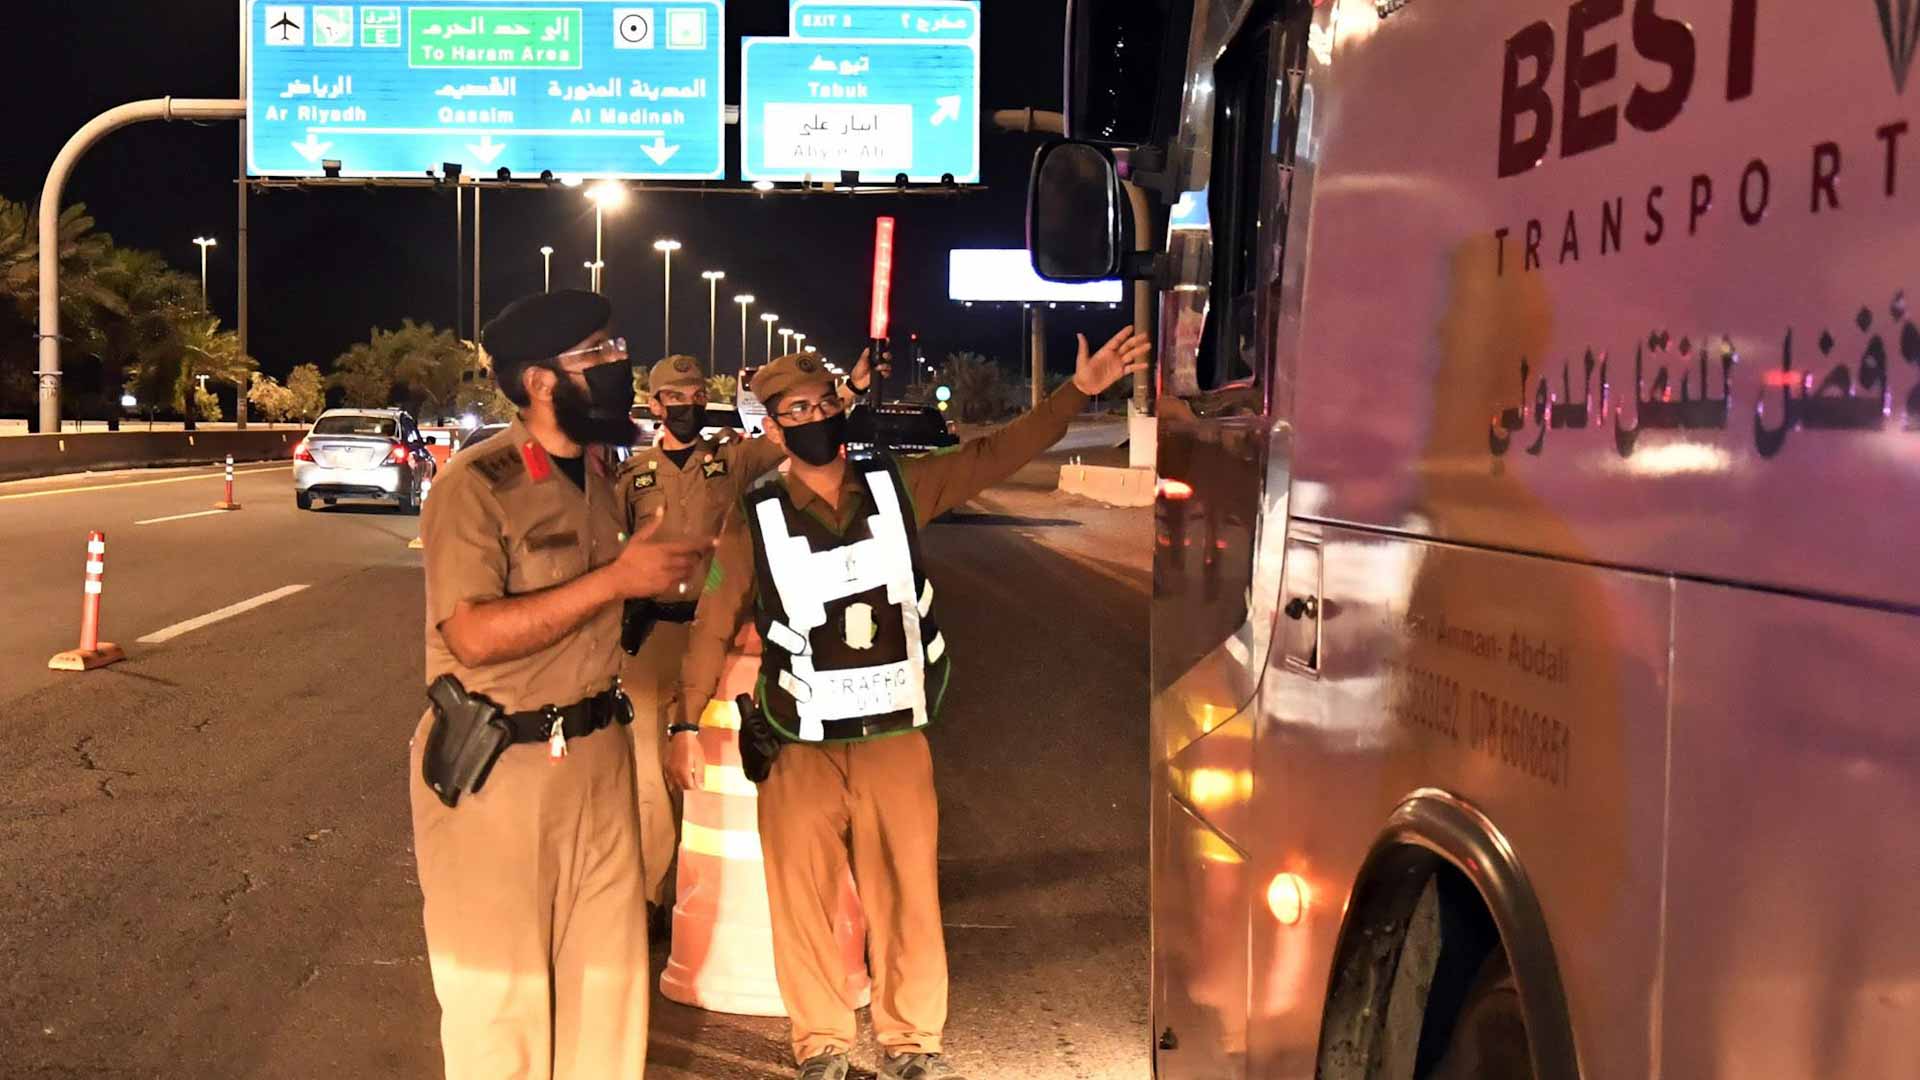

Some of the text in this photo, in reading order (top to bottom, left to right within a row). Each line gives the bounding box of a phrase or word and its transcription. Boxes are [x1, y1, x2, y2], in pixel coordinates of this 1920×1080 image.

[422, 16, 485, 39] الحرم
[802, 14, 837, 27] EXIT
[421, 45, 570, 62] To Haram Area
[808, 54, 870, 76] تبوك
[279, 75, 352, 99] الرياض
[434, 76, 516, 100] القصيم
[547, 78, 707, 101] المدينة المنورة
[807, 81, 868, 98] Tabuk
[265, 105, 367, 124] Ar Riyadh
[437, 107, 514, 124] Qassim
[570, 108, 685, 125] Al Madinah
[799, 114, 829, 136] علي
[1494, 120, 1910, 278] TRANSPORT
